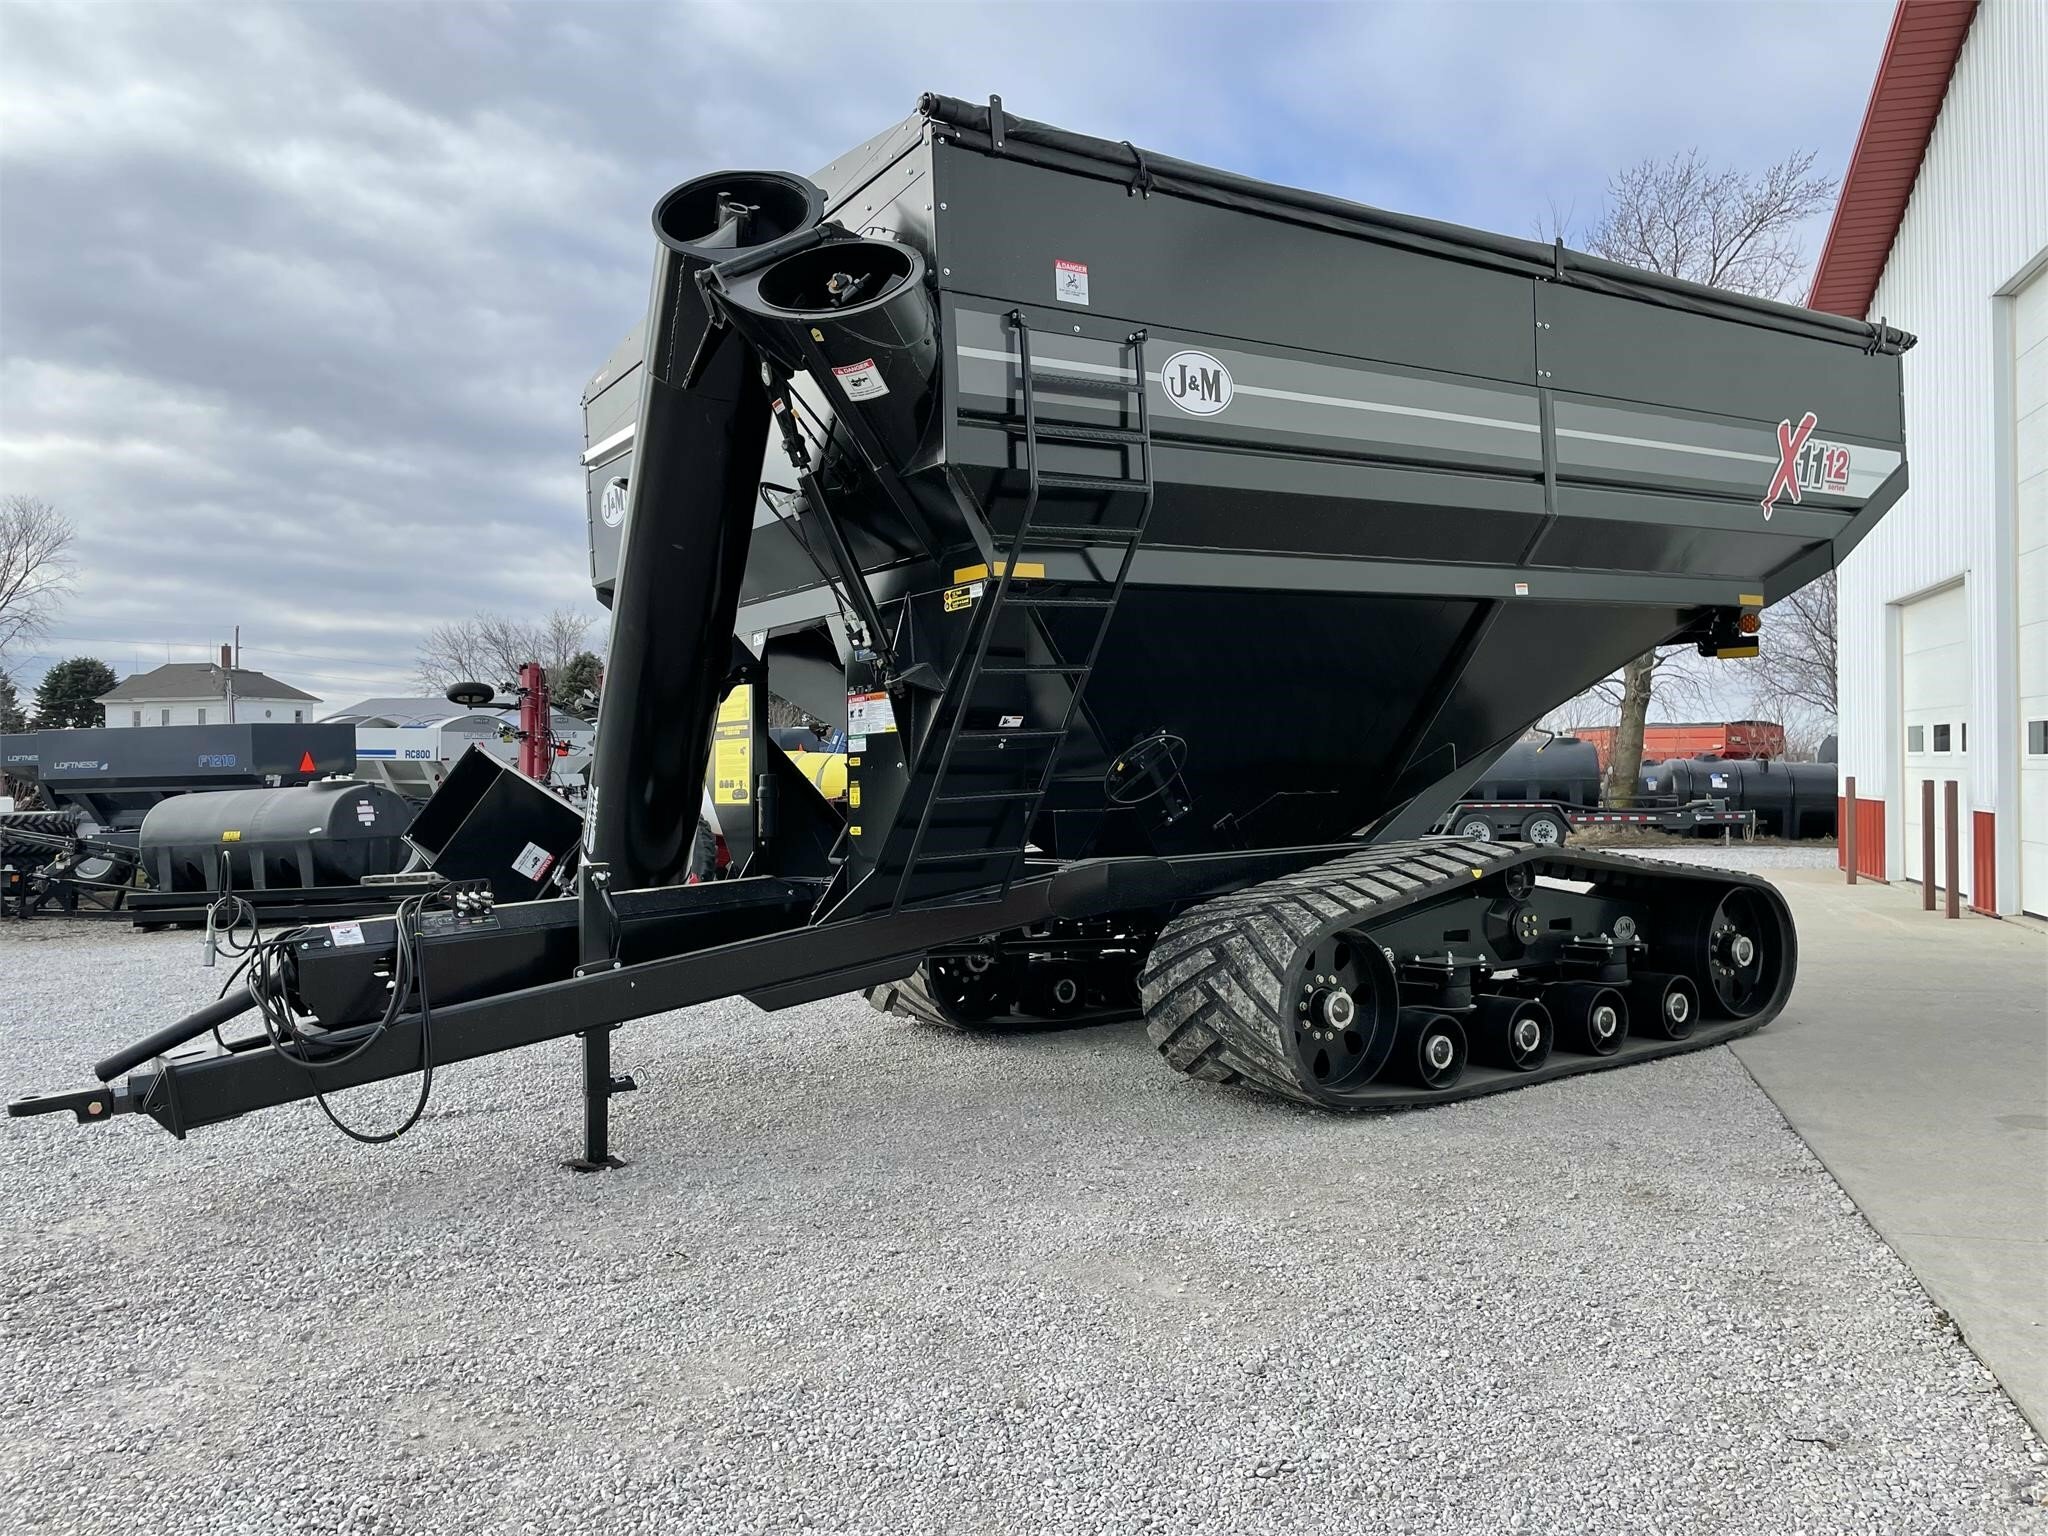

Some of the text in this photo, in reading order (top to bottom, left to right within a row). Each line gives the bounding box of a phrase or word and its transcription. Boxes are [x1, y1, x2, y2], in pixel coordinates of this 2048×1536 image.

[1061, 262, 1088, 273] DANGER
[843, 361, 870, 374] DANGER
[1169, 364, 1222, 403] J&M
[1828, 483, 1846, 492] series
[603, 487, 625, 519] J&M
[405, 749, 431, 759] RC800
[53, 760, 99, 770] LOFTNESS
[198, 754, 236, 768] F1210
